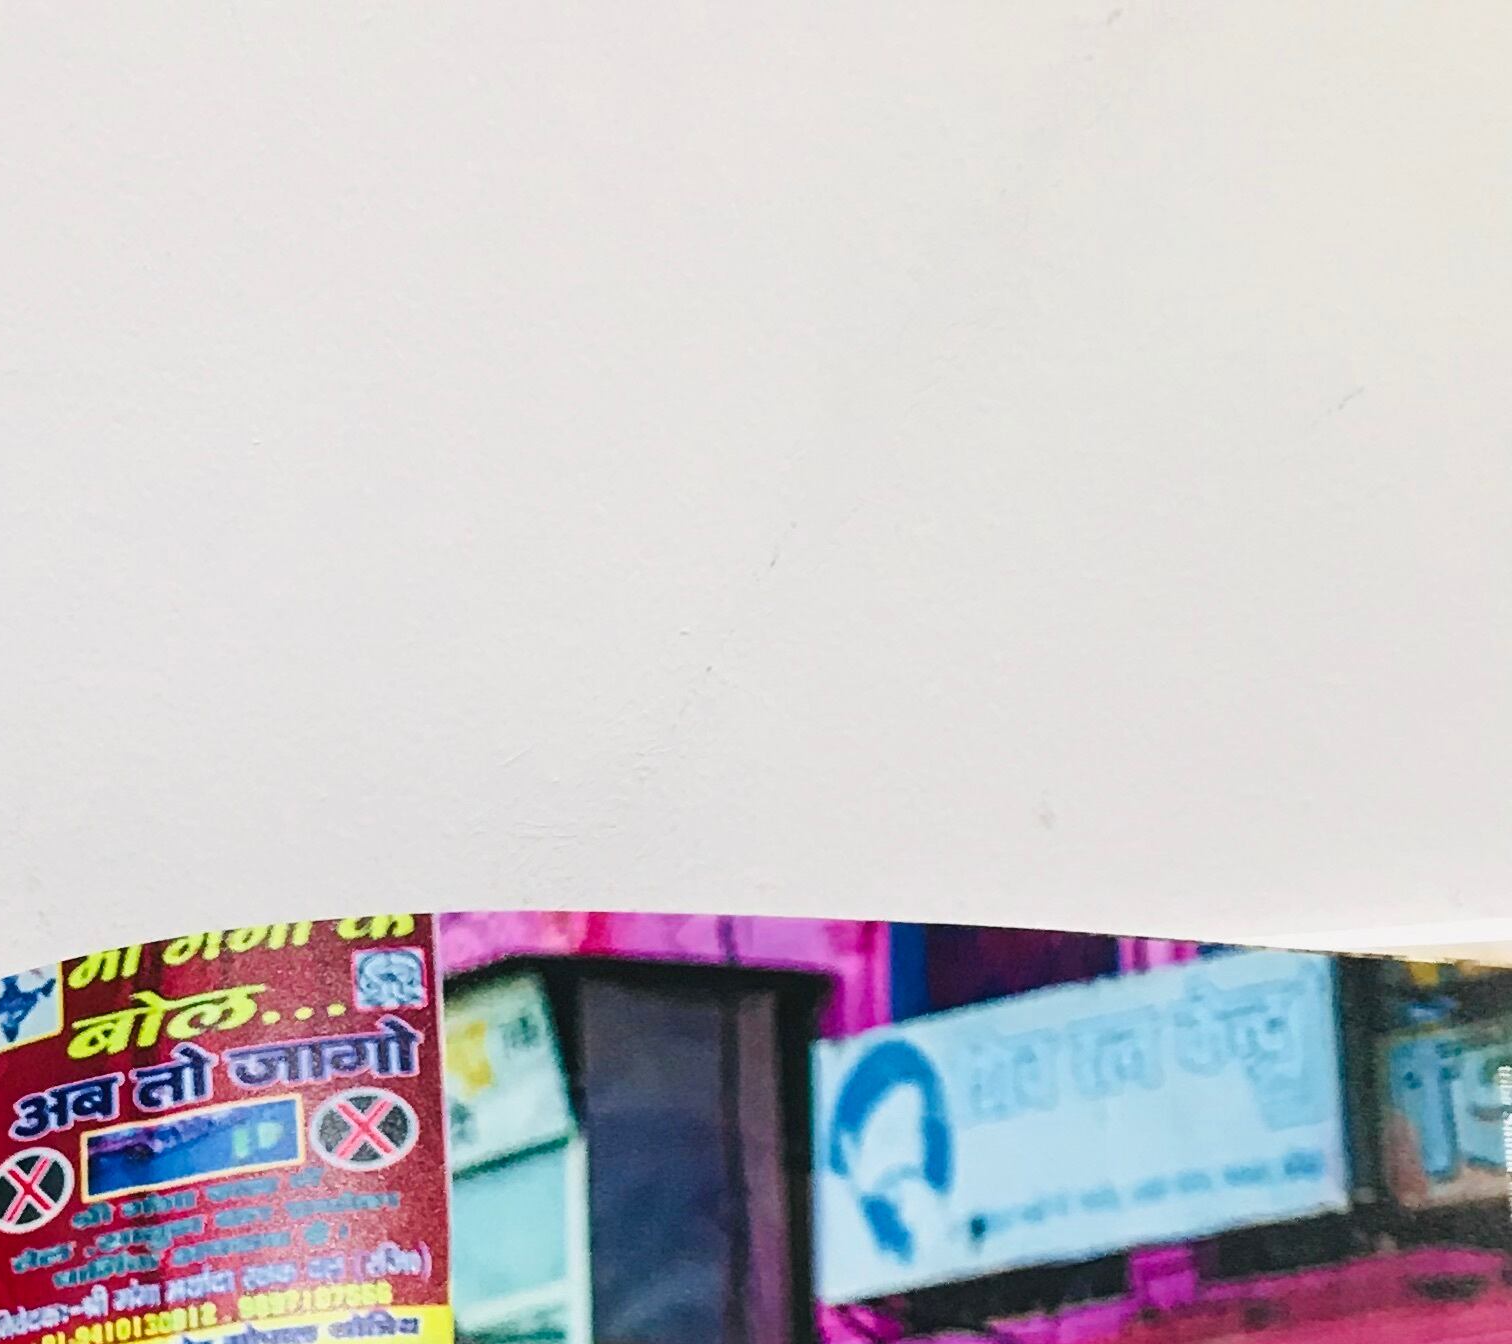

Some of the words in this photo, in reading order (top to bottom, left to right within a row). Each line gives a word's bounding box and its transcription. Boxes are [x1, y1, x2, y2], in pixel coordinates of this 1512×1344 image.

[9, 1073, 125, 1141] अब
[131, 1042, 219, 1112] तो
[221, 1014, 425, 1089] जागो
